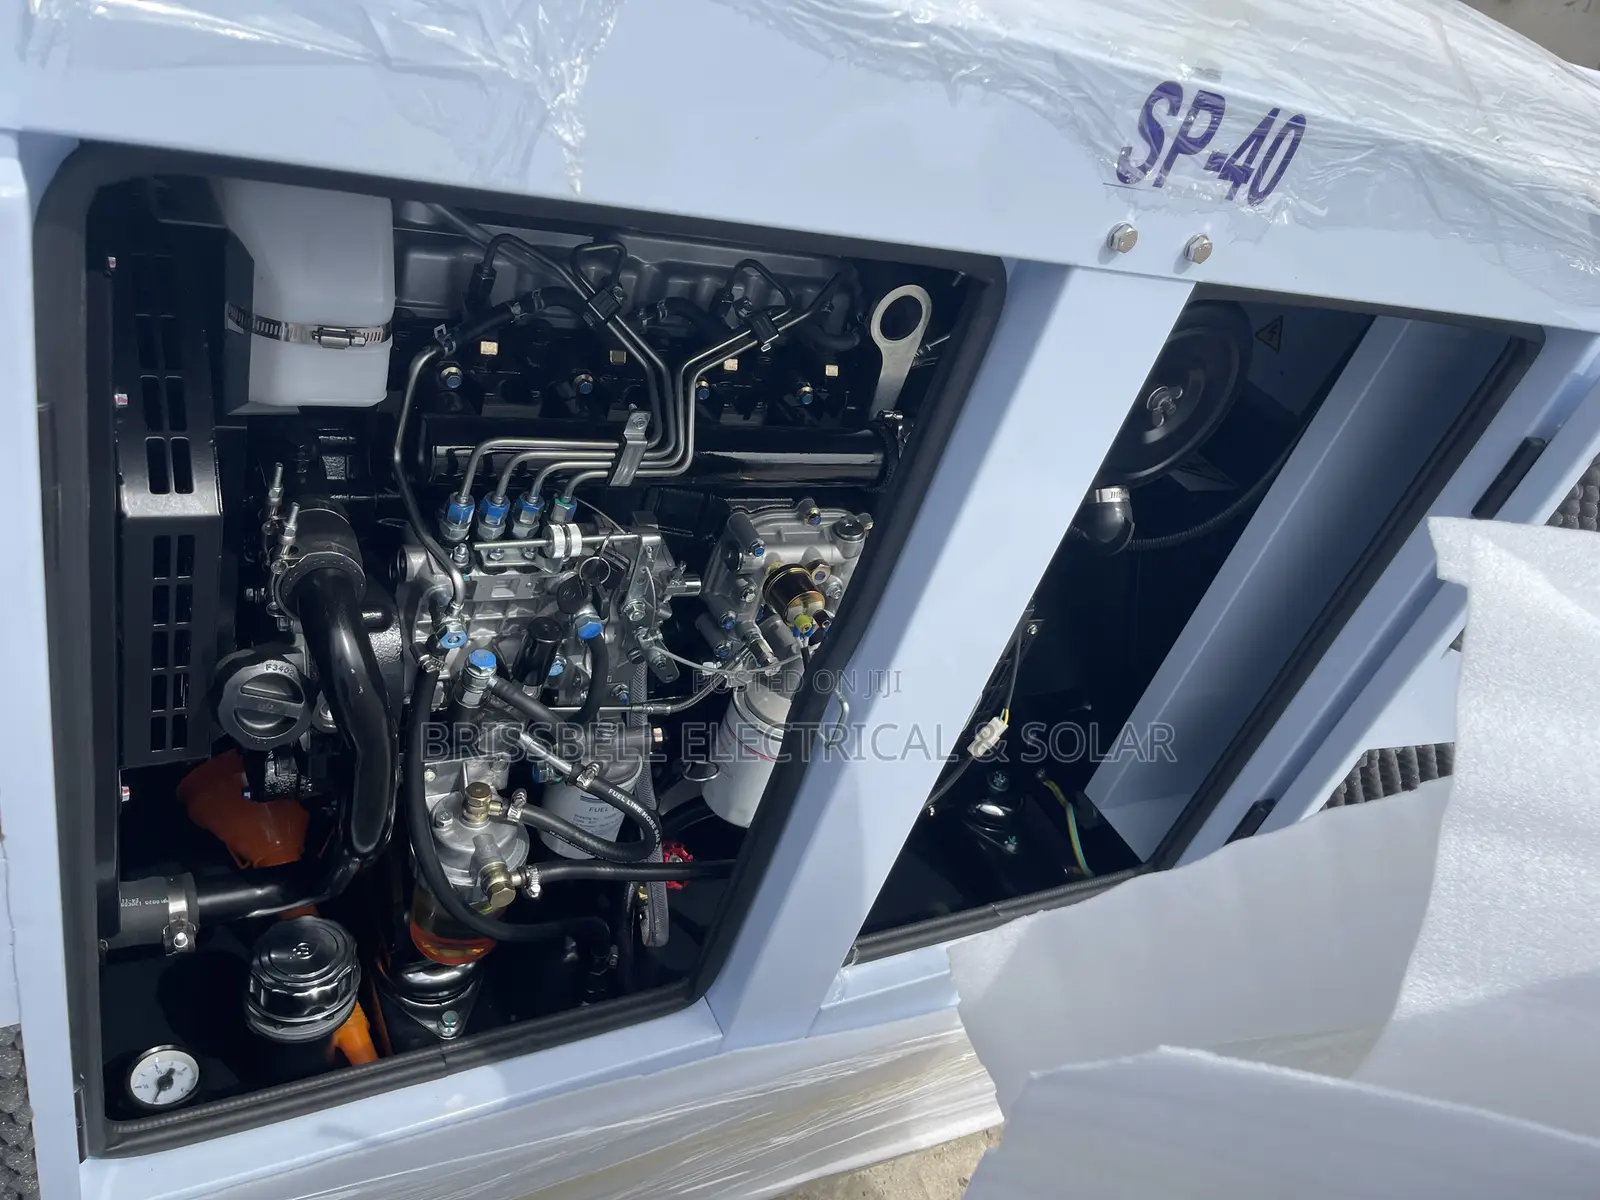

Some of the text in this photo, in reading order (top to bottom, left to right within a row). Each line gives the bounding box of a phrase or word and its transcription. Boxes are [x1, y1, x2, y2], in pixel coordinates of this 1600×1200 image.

[1116, 81, 1306, 206] SP-40
[608, 788, 626, 803] FUEL
[626, 799, 643, 814] LINE
[641, 811, 657, 830] HOSE
